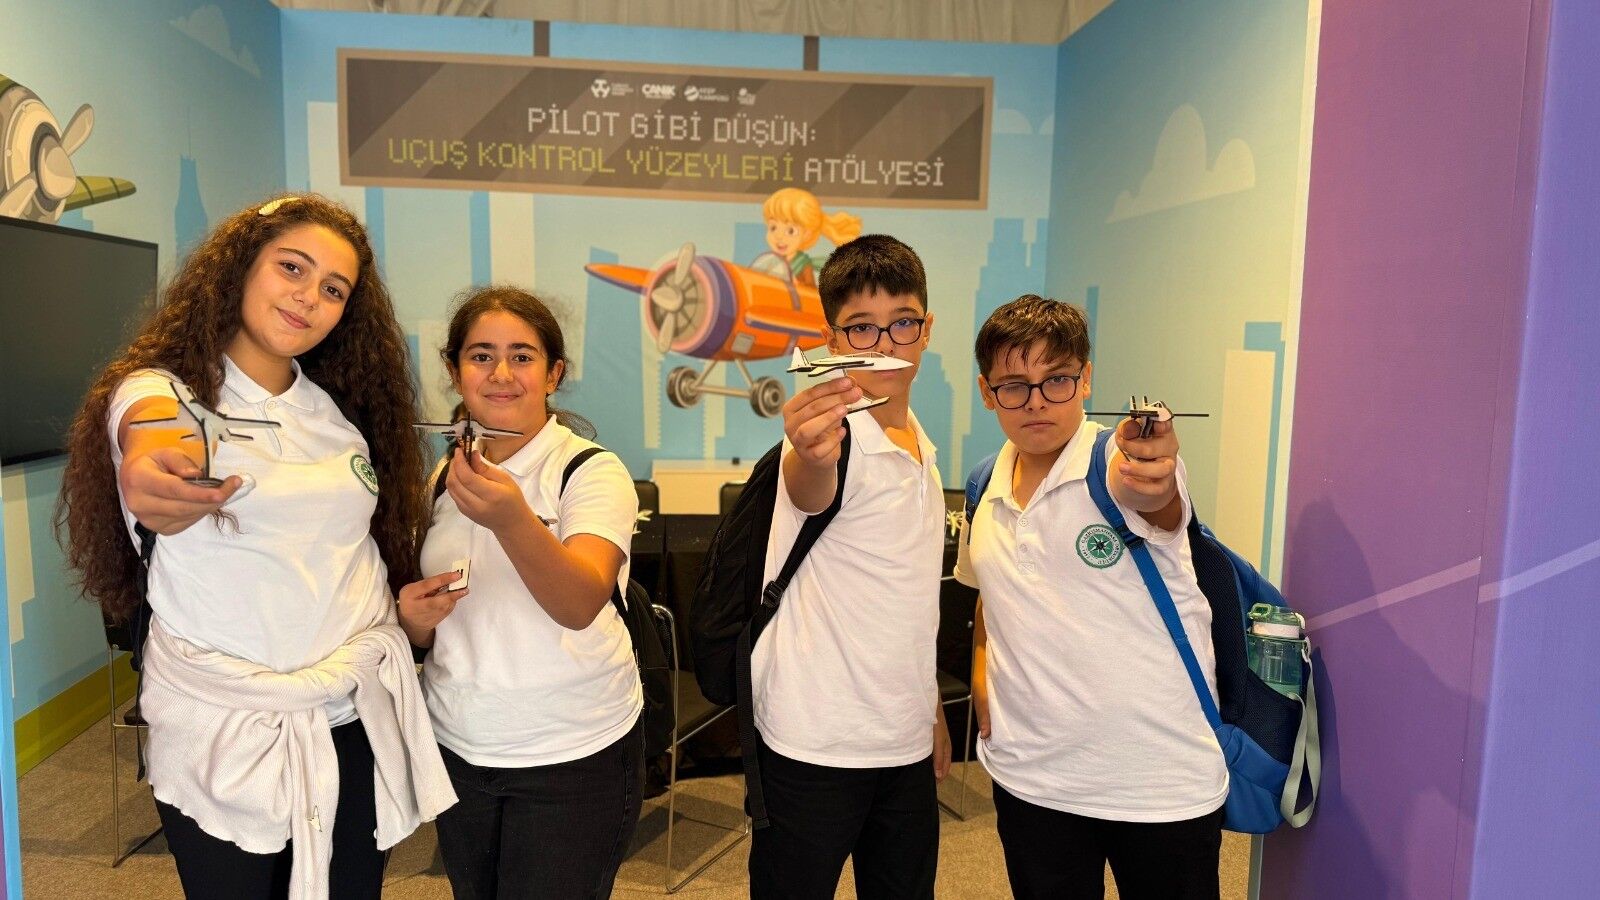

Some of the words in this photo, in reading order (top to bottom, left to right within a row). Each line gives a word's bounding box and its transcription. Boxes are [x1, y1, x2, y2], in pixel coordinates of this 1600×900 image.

[528, 103, 620, 137] PİLOT
[630, 109, 701, 142] GİBİ
[713, 112, 816, 148] DÜŞÜN:
[388, 138, 468, 170] UÇUŞ
[478, 141, 616, 173] KONTROL
[626, 146, 794, 182] YÜZEYLERİ
[804, 154, 944, 187] ATÖLYESİ
